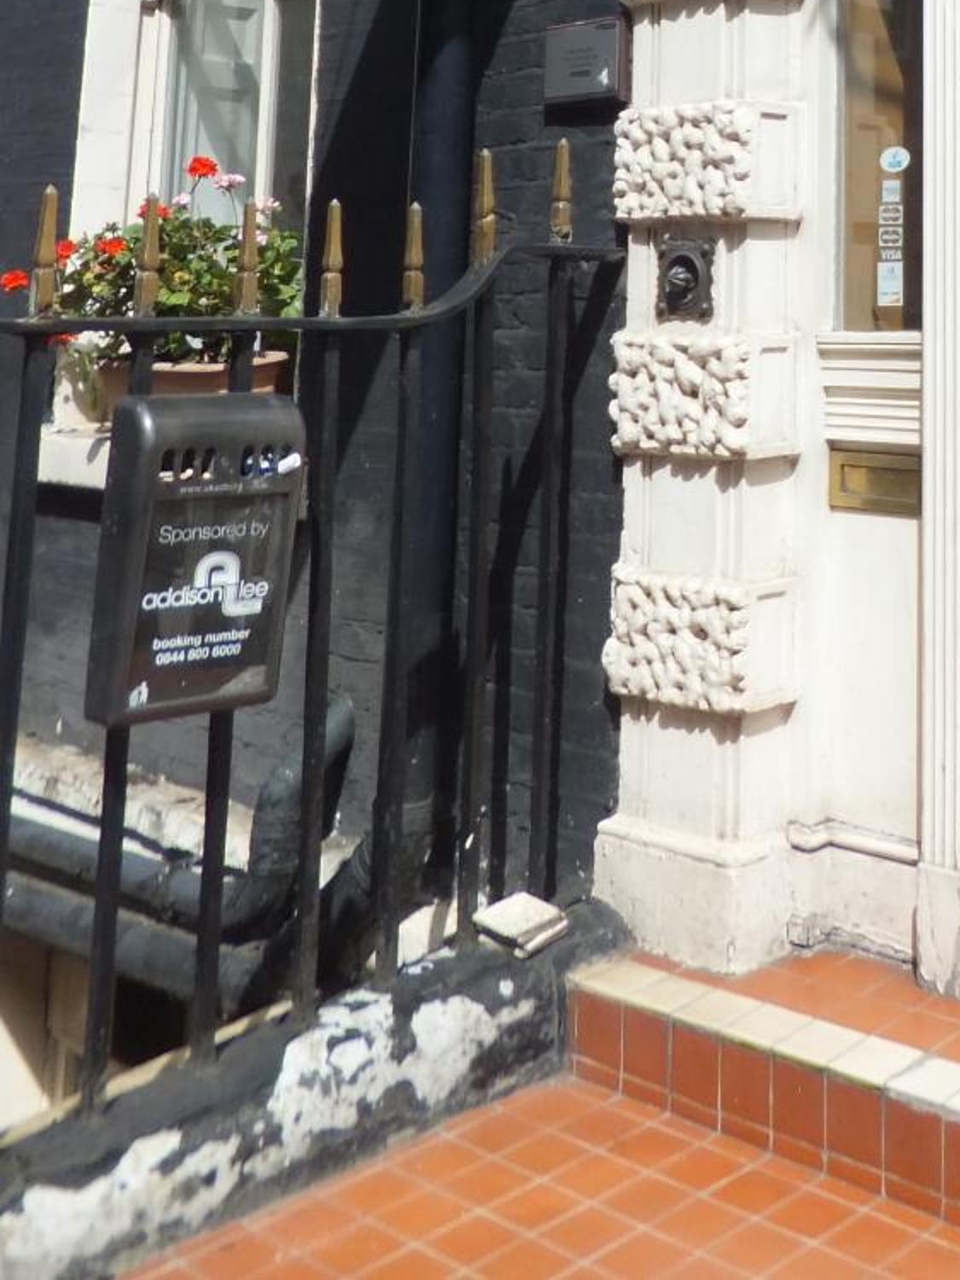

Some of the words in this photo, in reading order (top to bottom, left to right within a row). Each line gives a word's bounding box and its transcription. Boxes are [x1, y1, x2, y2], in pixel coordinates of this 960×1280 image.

[158, 521, 247, 547] Sponsored
[250, 520, 271, 539] by
[142, 585, 224, 611] addison
[240, 579, 269, 599] lee
[152, 634, 203, 651] booking
[204, 628, 251, 644] number
